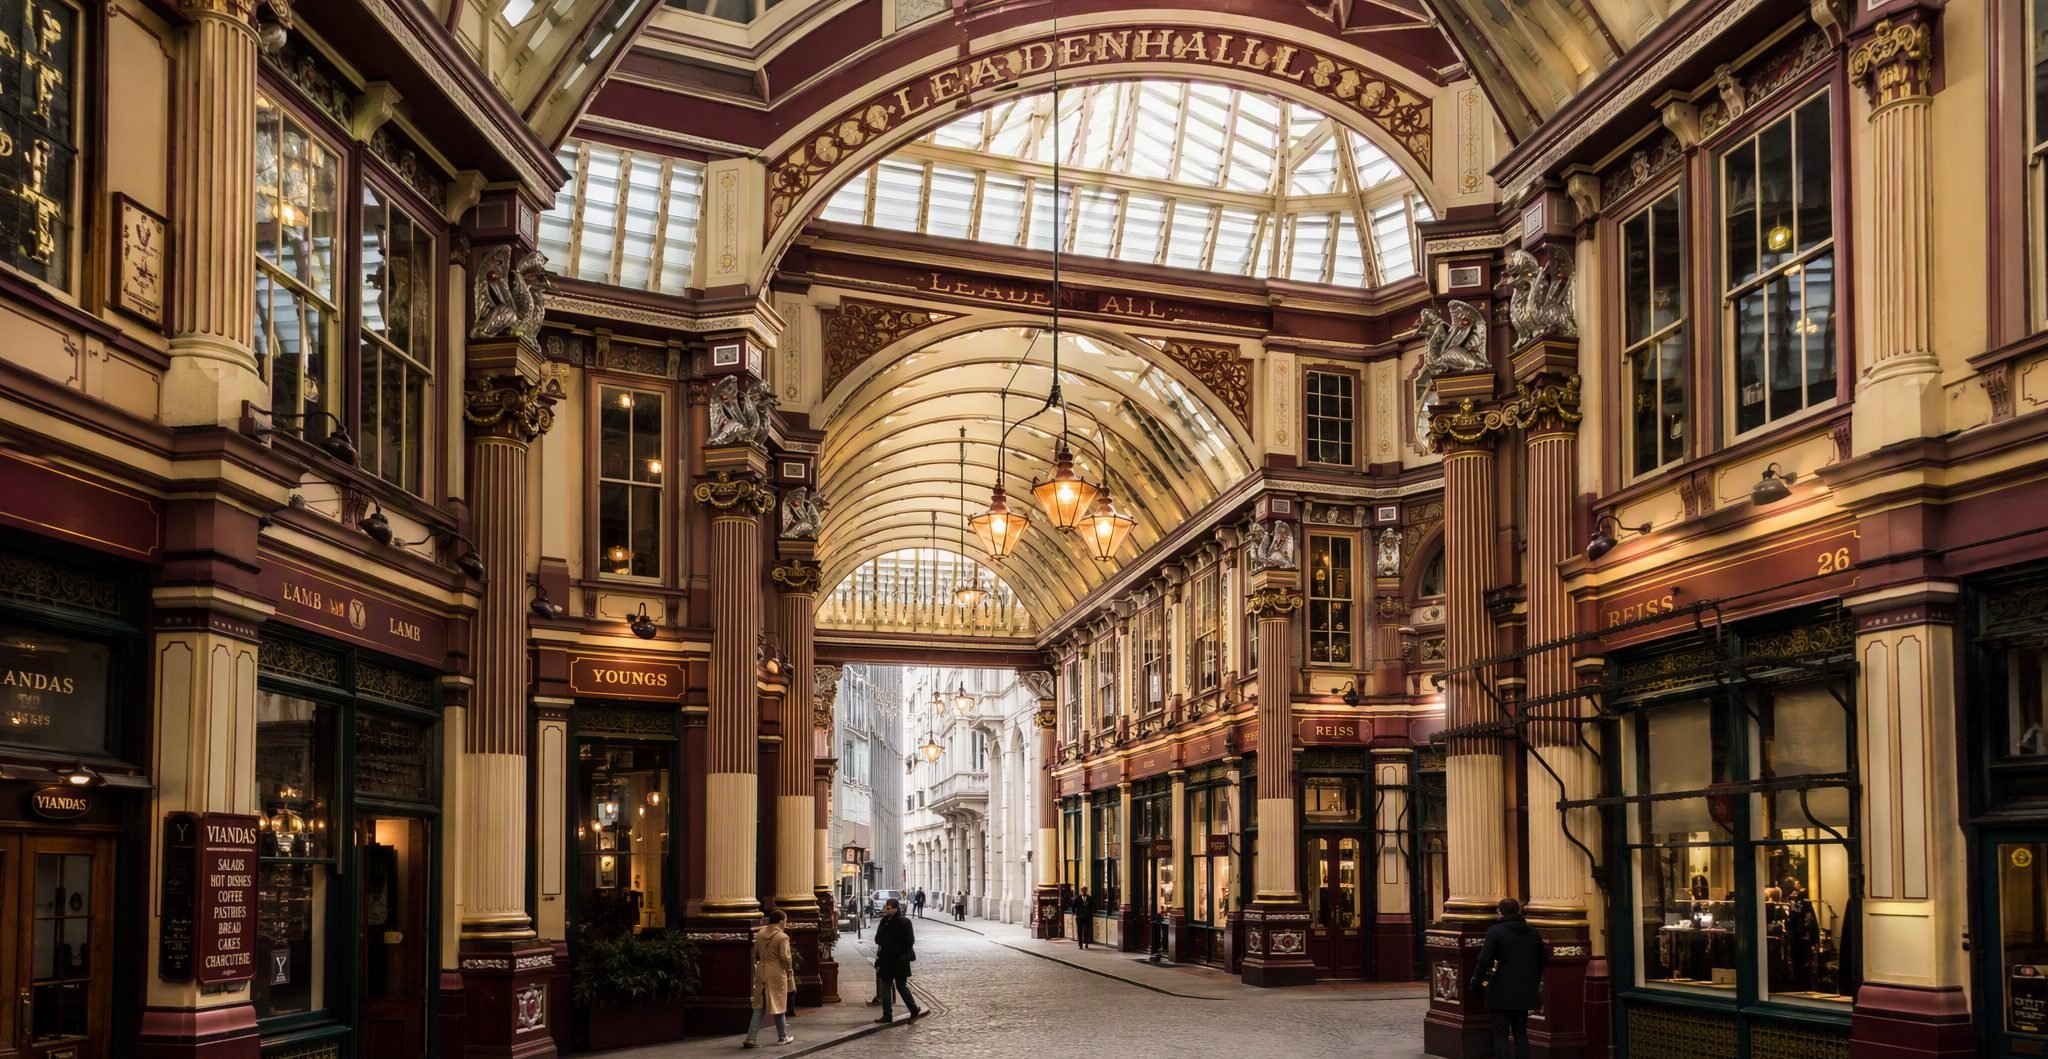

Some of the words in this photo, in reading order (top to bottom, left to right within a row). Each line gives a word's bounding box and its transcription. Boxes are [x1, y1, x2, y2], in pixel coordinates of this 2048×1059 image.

[898, 29, 1305, 118] LEADENHALL
[929, 272, 1165, 318] LEADENALL
[1608, 595, 1674, 628] REISS
[1817, 547, 1850, 576] 26
[389, 617, 421, 642] LAMB
[0, 670, 74, 694] ANDAS
[592, 669, 668, 687] YOUNGS
[1315, 726, 1354, 736] REISS
[207, 826, 257, 844] VIANDAS
[217, 859, 245, 871] SALADS
[210, 875, 225, 887] HOT
[217, 891, 243, 903] COFFEE
[213, 906, 247, 919] PASTRIES
[218, 922, 242, 935] BREAD
[217, 938, 241, 950] CAKES
